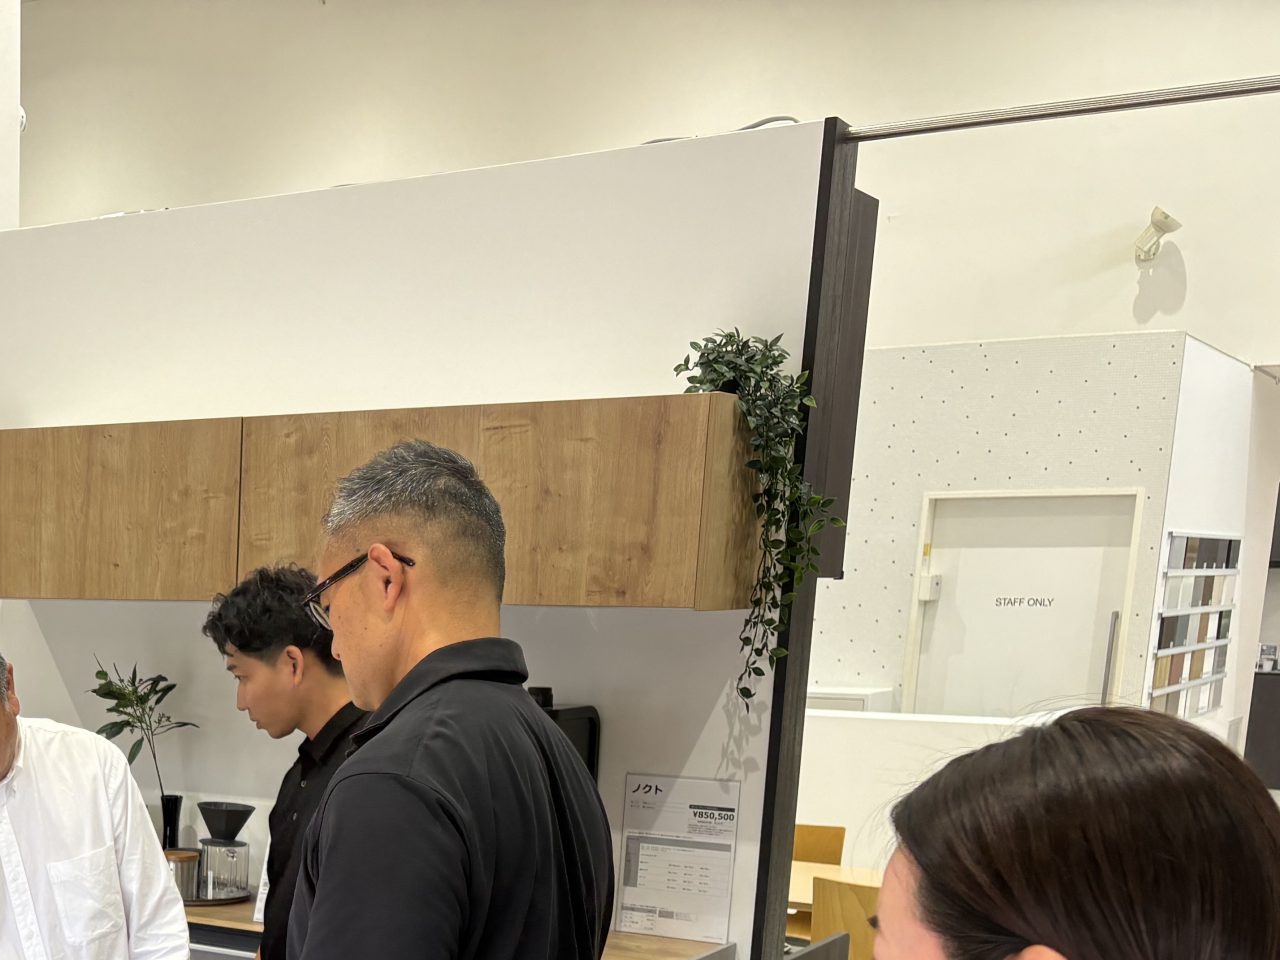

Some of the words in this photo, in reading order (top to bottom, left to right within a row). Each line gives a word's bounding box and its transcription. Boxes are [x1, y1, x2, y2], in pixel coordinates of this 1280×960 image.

[995, 597, 1025, 607] STAFF
[1027, 597, 1055, 607] ONLY
[632, 783, 663, 795] ノクト
[693, 810, 735, 821] ¥850,500
